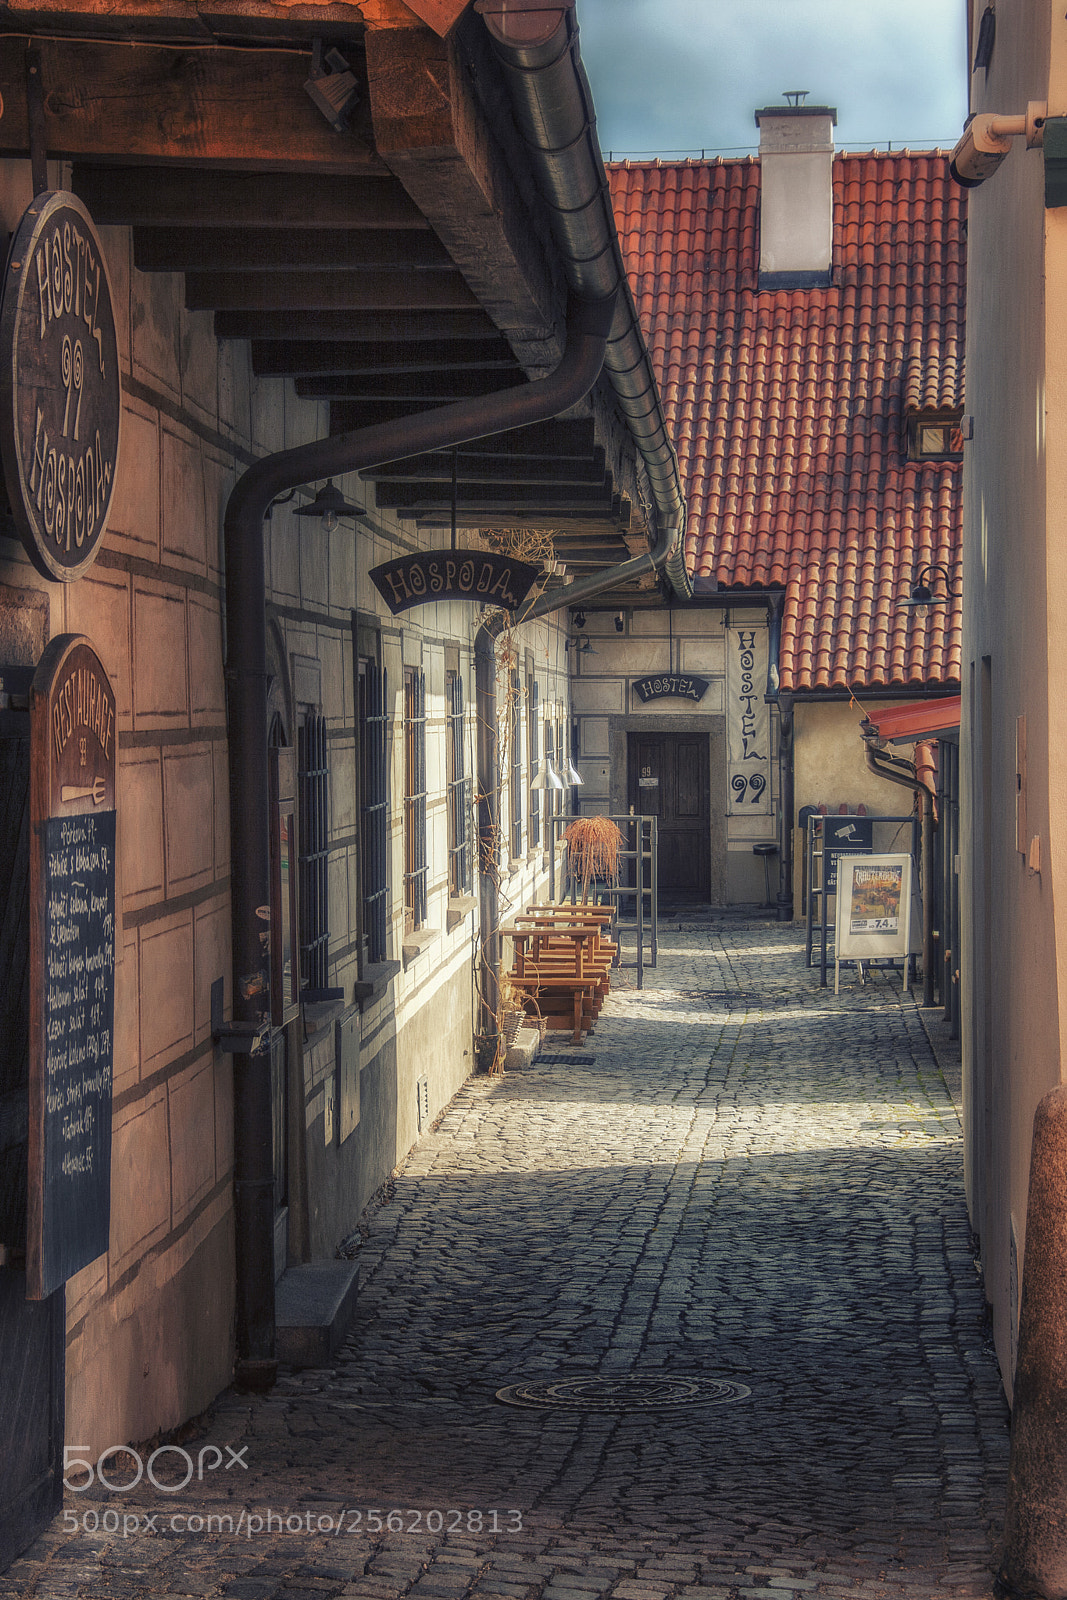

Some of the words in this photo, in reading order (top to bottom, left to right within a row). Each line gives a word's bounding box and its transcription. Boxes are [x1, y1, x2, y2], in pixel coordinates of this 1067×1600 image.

[35, 221, 106, 380] HOSTEL
[61, 334, 84, 441] 99
[29, 406, 111, 552] HOSPODA
[385, 560, 518, 607] HOSPODA
[53, 668, 114, 763] RESTAURACE
[642, 677, 700, 699] HOSTEL
[737, 631, 767, 760] HOSTEL
[641, 766, 651, 777] 99
[731, 773, 766, 803] 99
